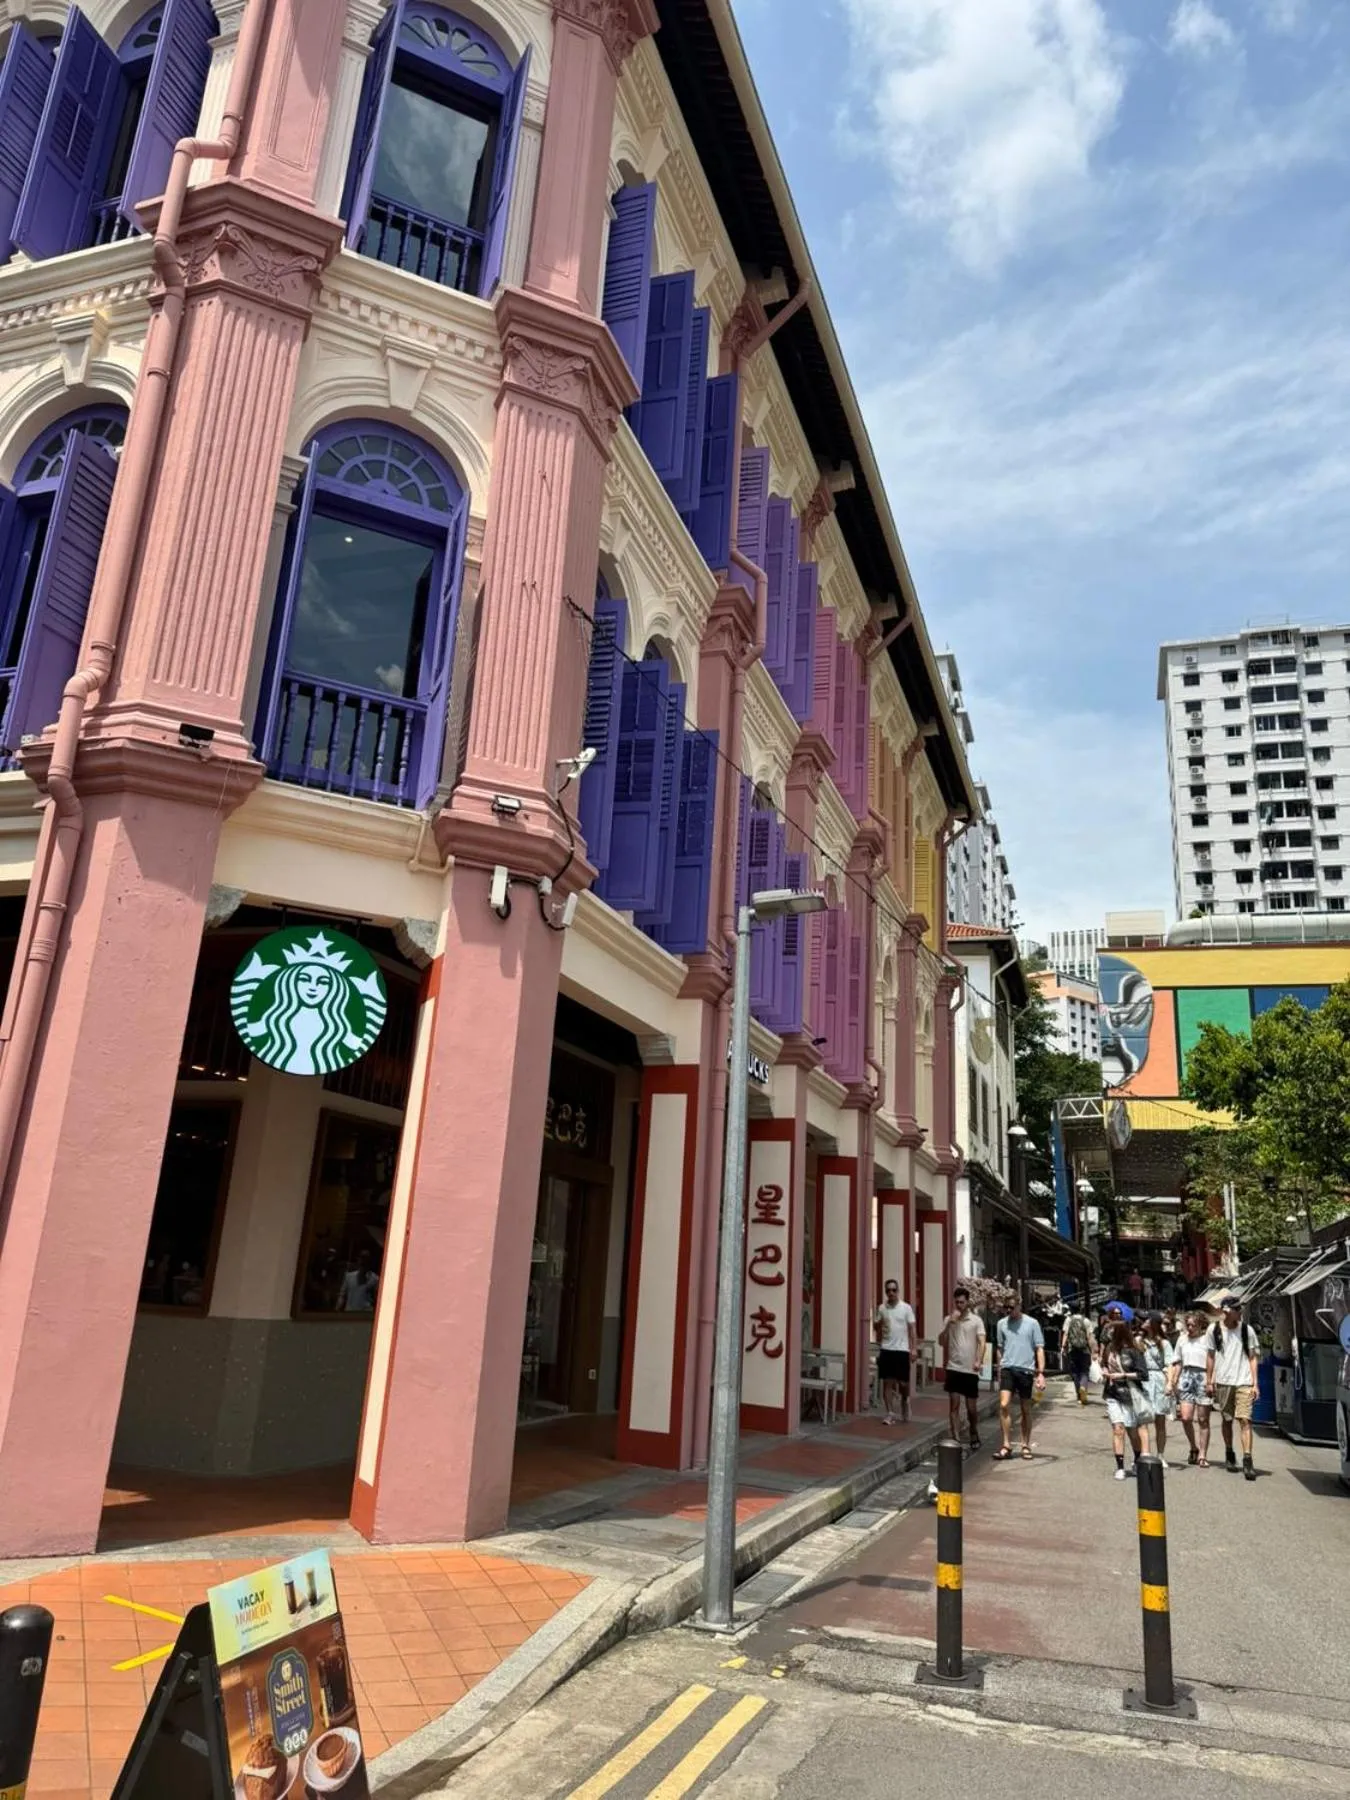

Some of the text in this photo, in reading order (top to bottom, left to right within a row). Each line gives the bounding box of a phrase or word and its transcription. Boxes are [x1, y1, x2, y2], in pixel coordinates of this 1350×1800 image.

[746, 1184, 786, 1359] 星巴克
[237, 1590, 266, 1610] VACAY
[274, 1673, 304, 1699] Smith
[275, 1690, 307, 1719] Street
